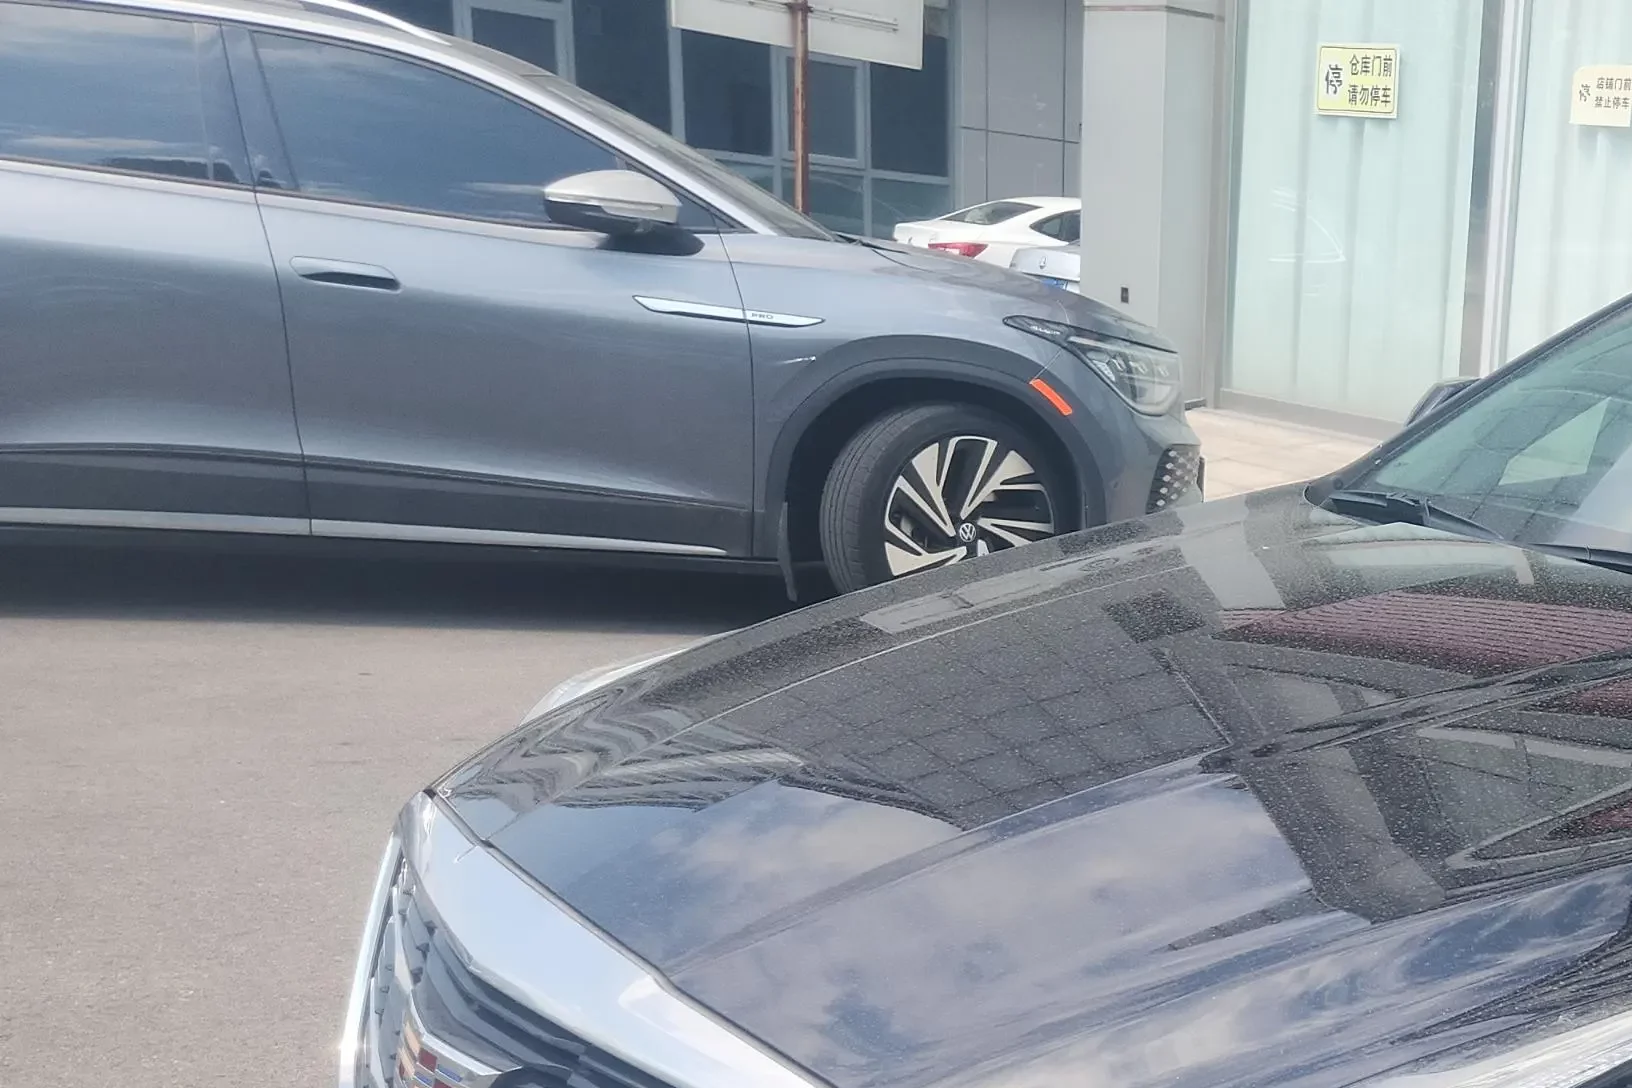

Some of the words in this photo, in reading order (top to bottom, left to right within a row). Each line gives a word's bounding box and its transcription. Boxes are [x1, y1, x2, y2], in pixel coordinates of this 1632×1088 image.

[1349, 54, 1393, 77] 仓库门前
[1348, 84, 1392, 107] 请勿停车
